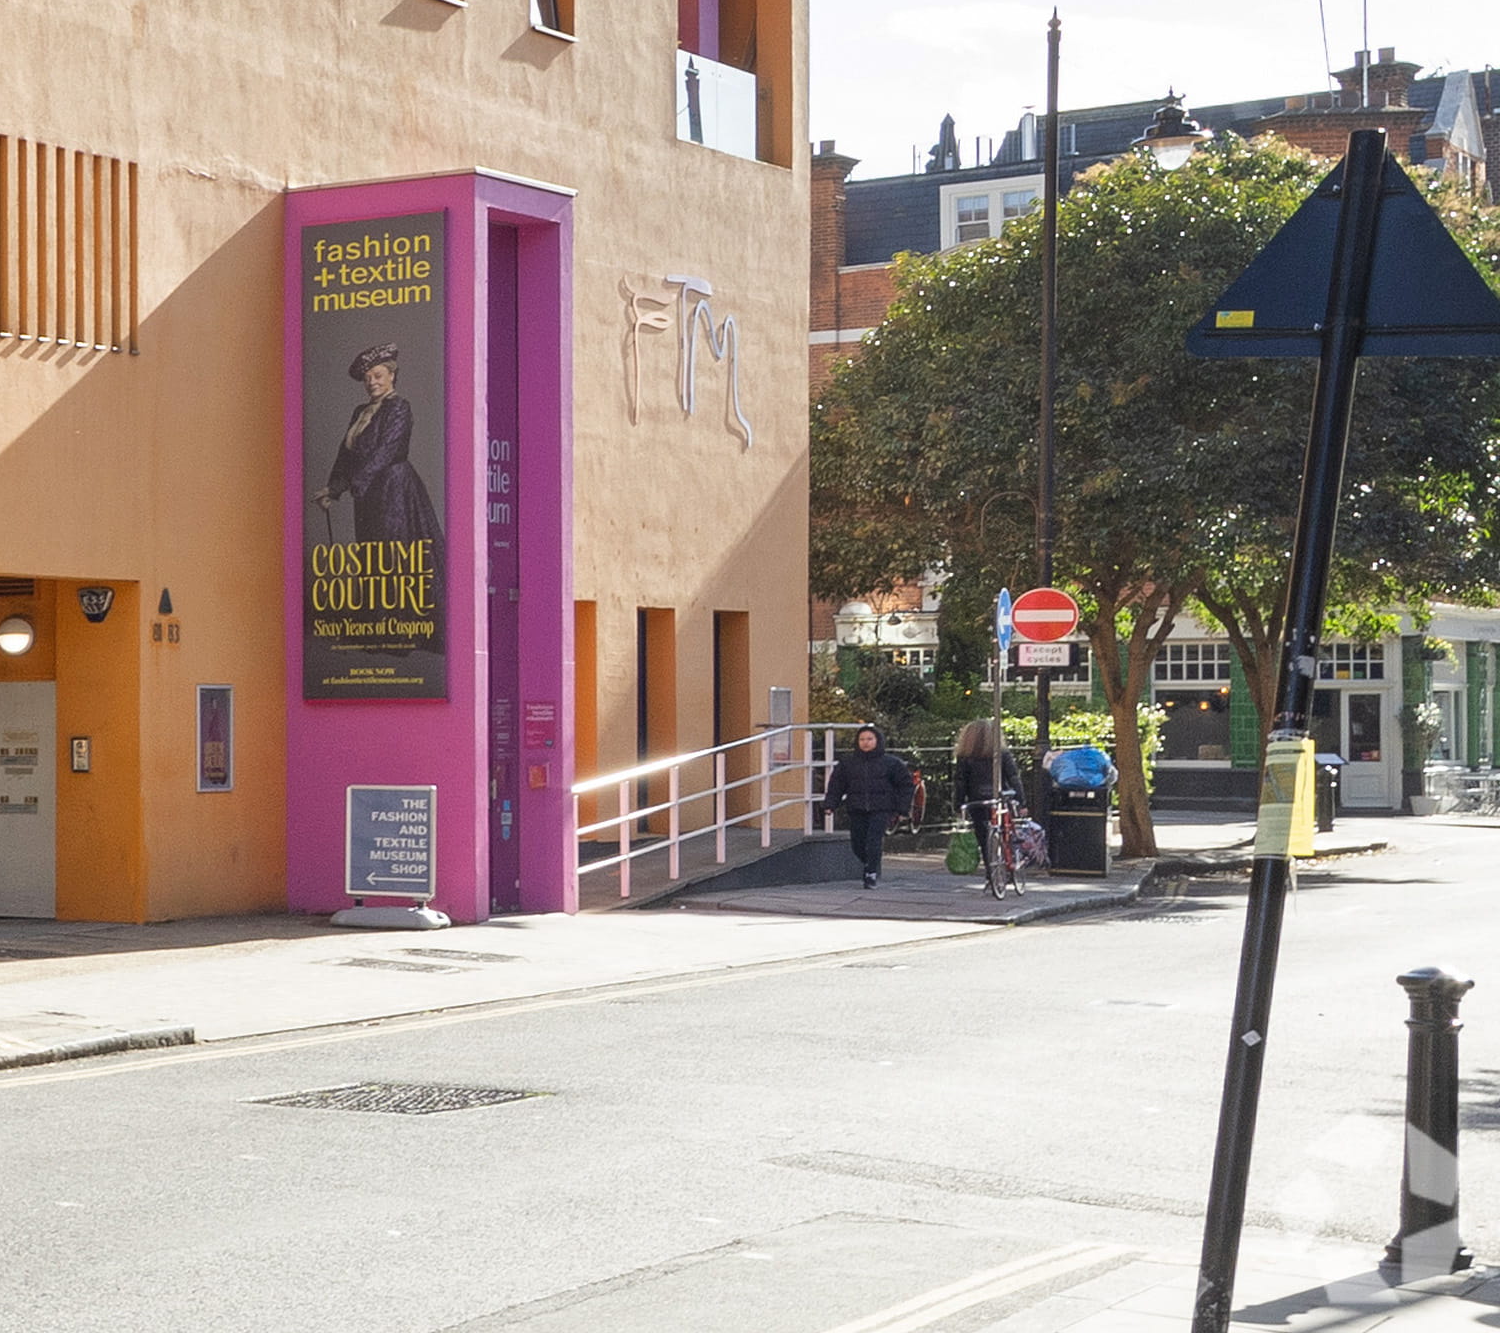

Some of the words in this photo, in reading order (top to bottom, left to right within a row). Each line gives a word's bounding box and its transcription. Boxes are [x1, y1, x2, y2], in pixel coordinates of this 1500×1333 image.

[313, 232, 431, 264] fashion
[313, 284, 431, 312] museum
[312, 538, 434, 577] COSTUME
[312, 574, 435, 617] COUTURE
[313, 619, 343, 641] Sixty
[342, 617, 375, 637] Years
[375, 616, 387, 635] of
[387, 617, 435, 640] Cosprop
[1025, 646, 1063, 654] Except
[1026, 656, 1062, 664] cycles
[401, 798, 428, 810] THE
[371, 811, 428, 823] FASHION
[399, 824, 428, 835] AND
[373, 837, 428, 849] TEXTILE
[369, 850, 428, 862] MUSEUM
[390, 863, 428, 875] SHOP
